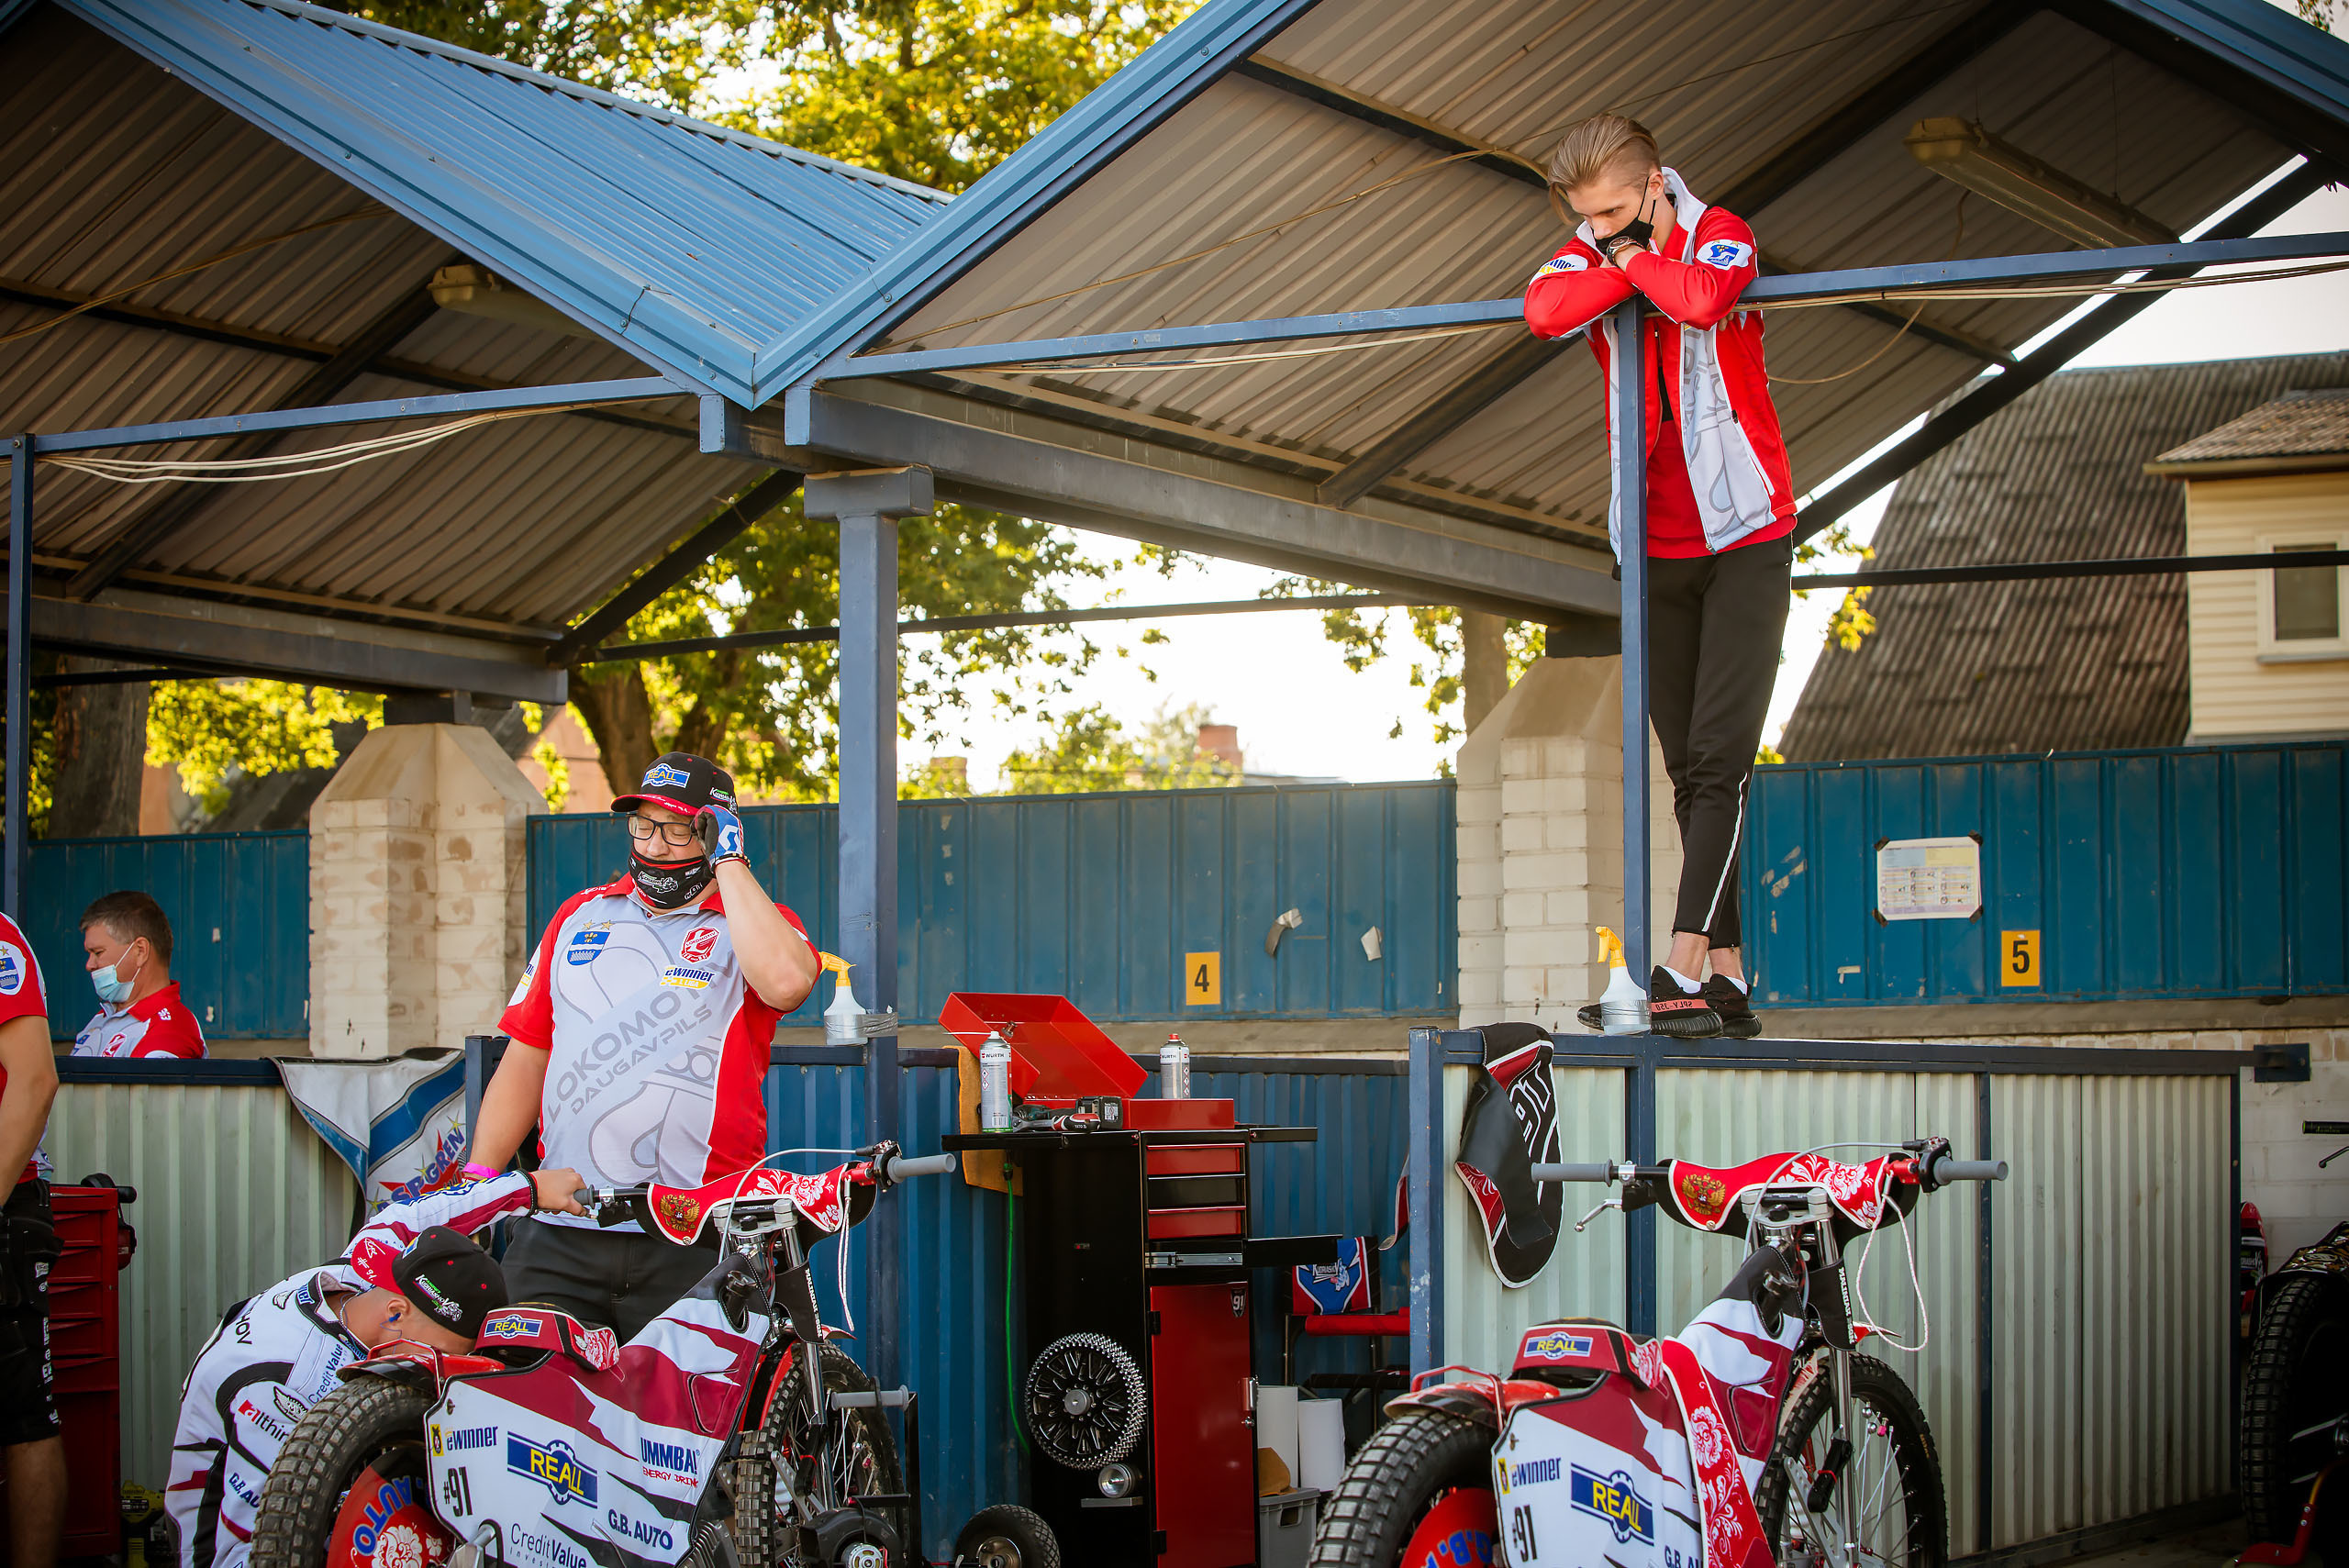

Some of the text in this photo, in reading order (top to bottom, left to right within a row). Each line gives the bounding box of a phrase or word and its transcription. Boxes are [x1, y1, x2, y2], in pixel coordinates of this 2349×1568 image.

[647, 771, 676, 782] REALL
[2012, 940, 2031, 974] 5
[664, 967, 716, 982] eWinner
[1194, 963, 1210, 993] 4
[548, 950, 736, 1124] LOKOMOV
[571, 1004, 714, 1116] DAUGAVPILS
[1232, 1295, 1244, 1311] 91
[494, 1321, 529, 1332] REALL
[1536, 1340, 1577, 1351] REALL
[446, 1426, 498, 1451] eWinner
[530, 1448, 584, 1496] REALL
[640, 1437, 698, 1475] UMMBA!
[1511, 1457, 1562, 1487] eWinner
[443, 1466, 473, 1518] #91
[642, 1466, 699, 1488] ENERGY DRINK
[352, 1474, 414, 1557] AUTO
[1592, 1481, 1642, 1532] REALL
[607, 1508, 674, 1551] G.B. AUTO
